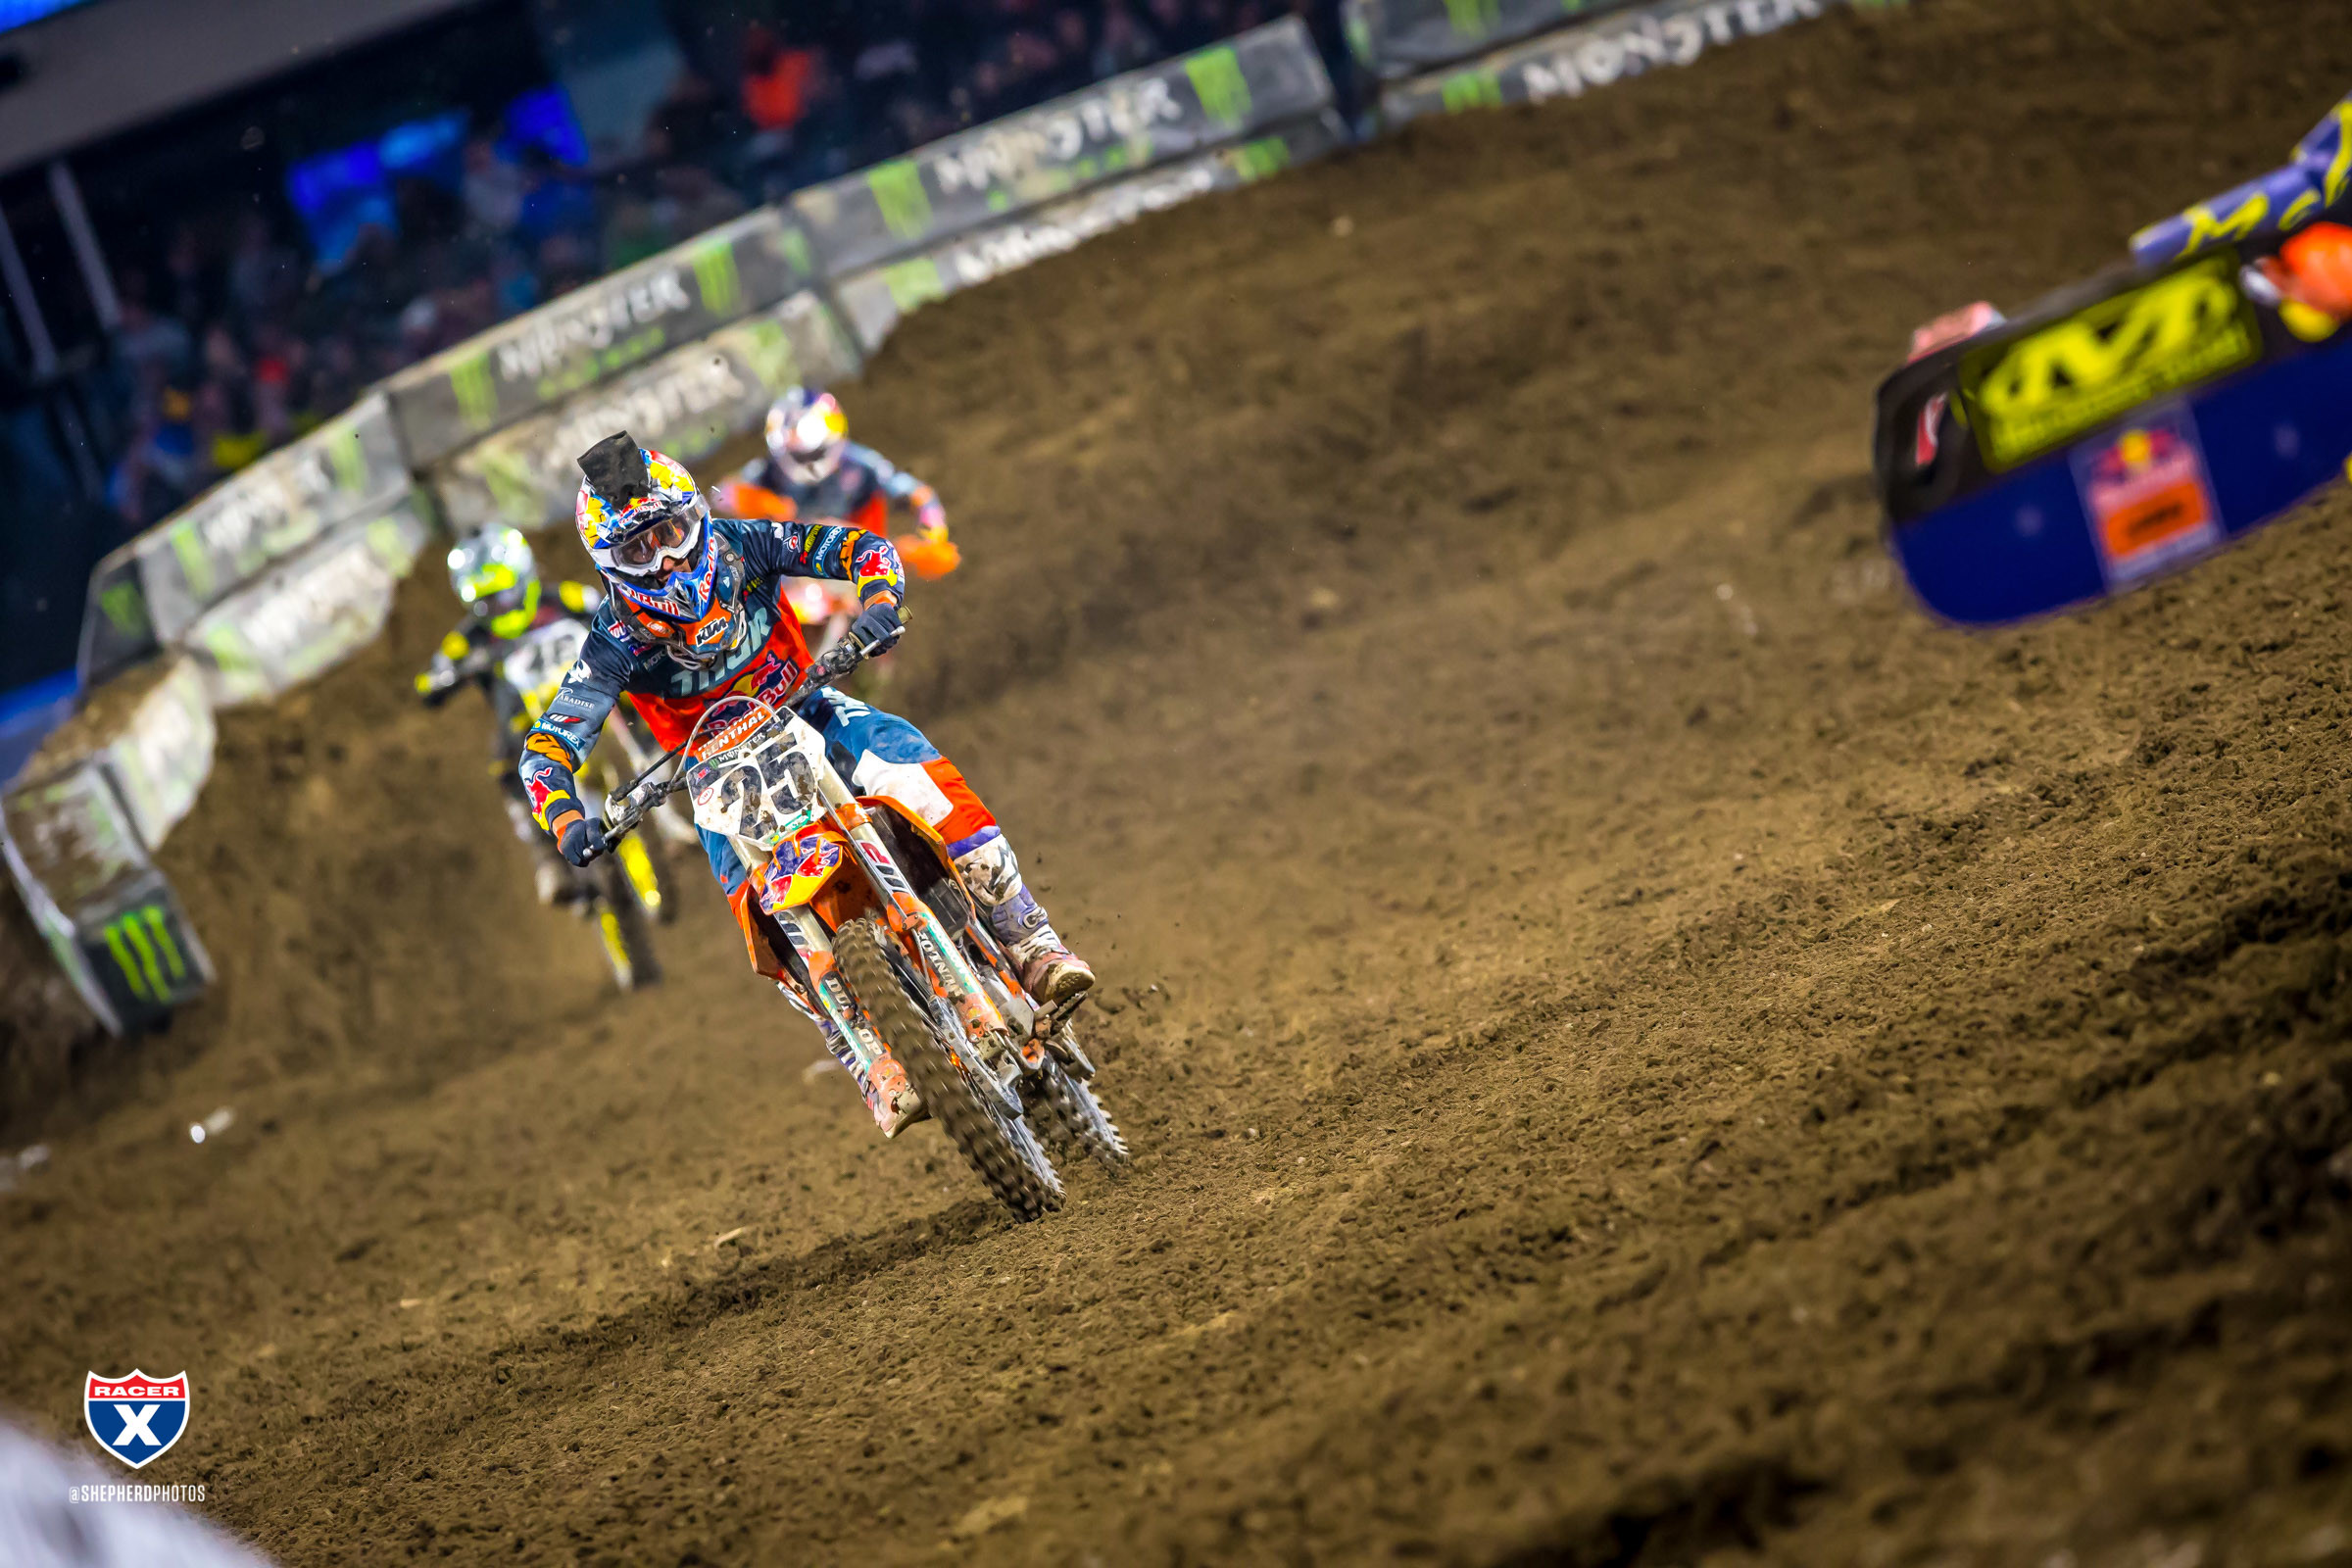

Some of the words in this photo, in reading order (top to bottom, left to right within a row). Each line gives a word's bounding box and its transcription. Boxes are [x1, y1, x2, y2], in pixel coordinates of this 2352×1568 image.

[695, 616, 728, 647] KTM
[554, 687, 595, 710] PARADISE
[758, 660, 800, 707] Bull
[541, 721, 580, 747] MOTOREX
[701, 710, 765, 760] RENTHAL
[720, 732, 815, 840] 25
[824, 977, 884, 1055] DUOP
